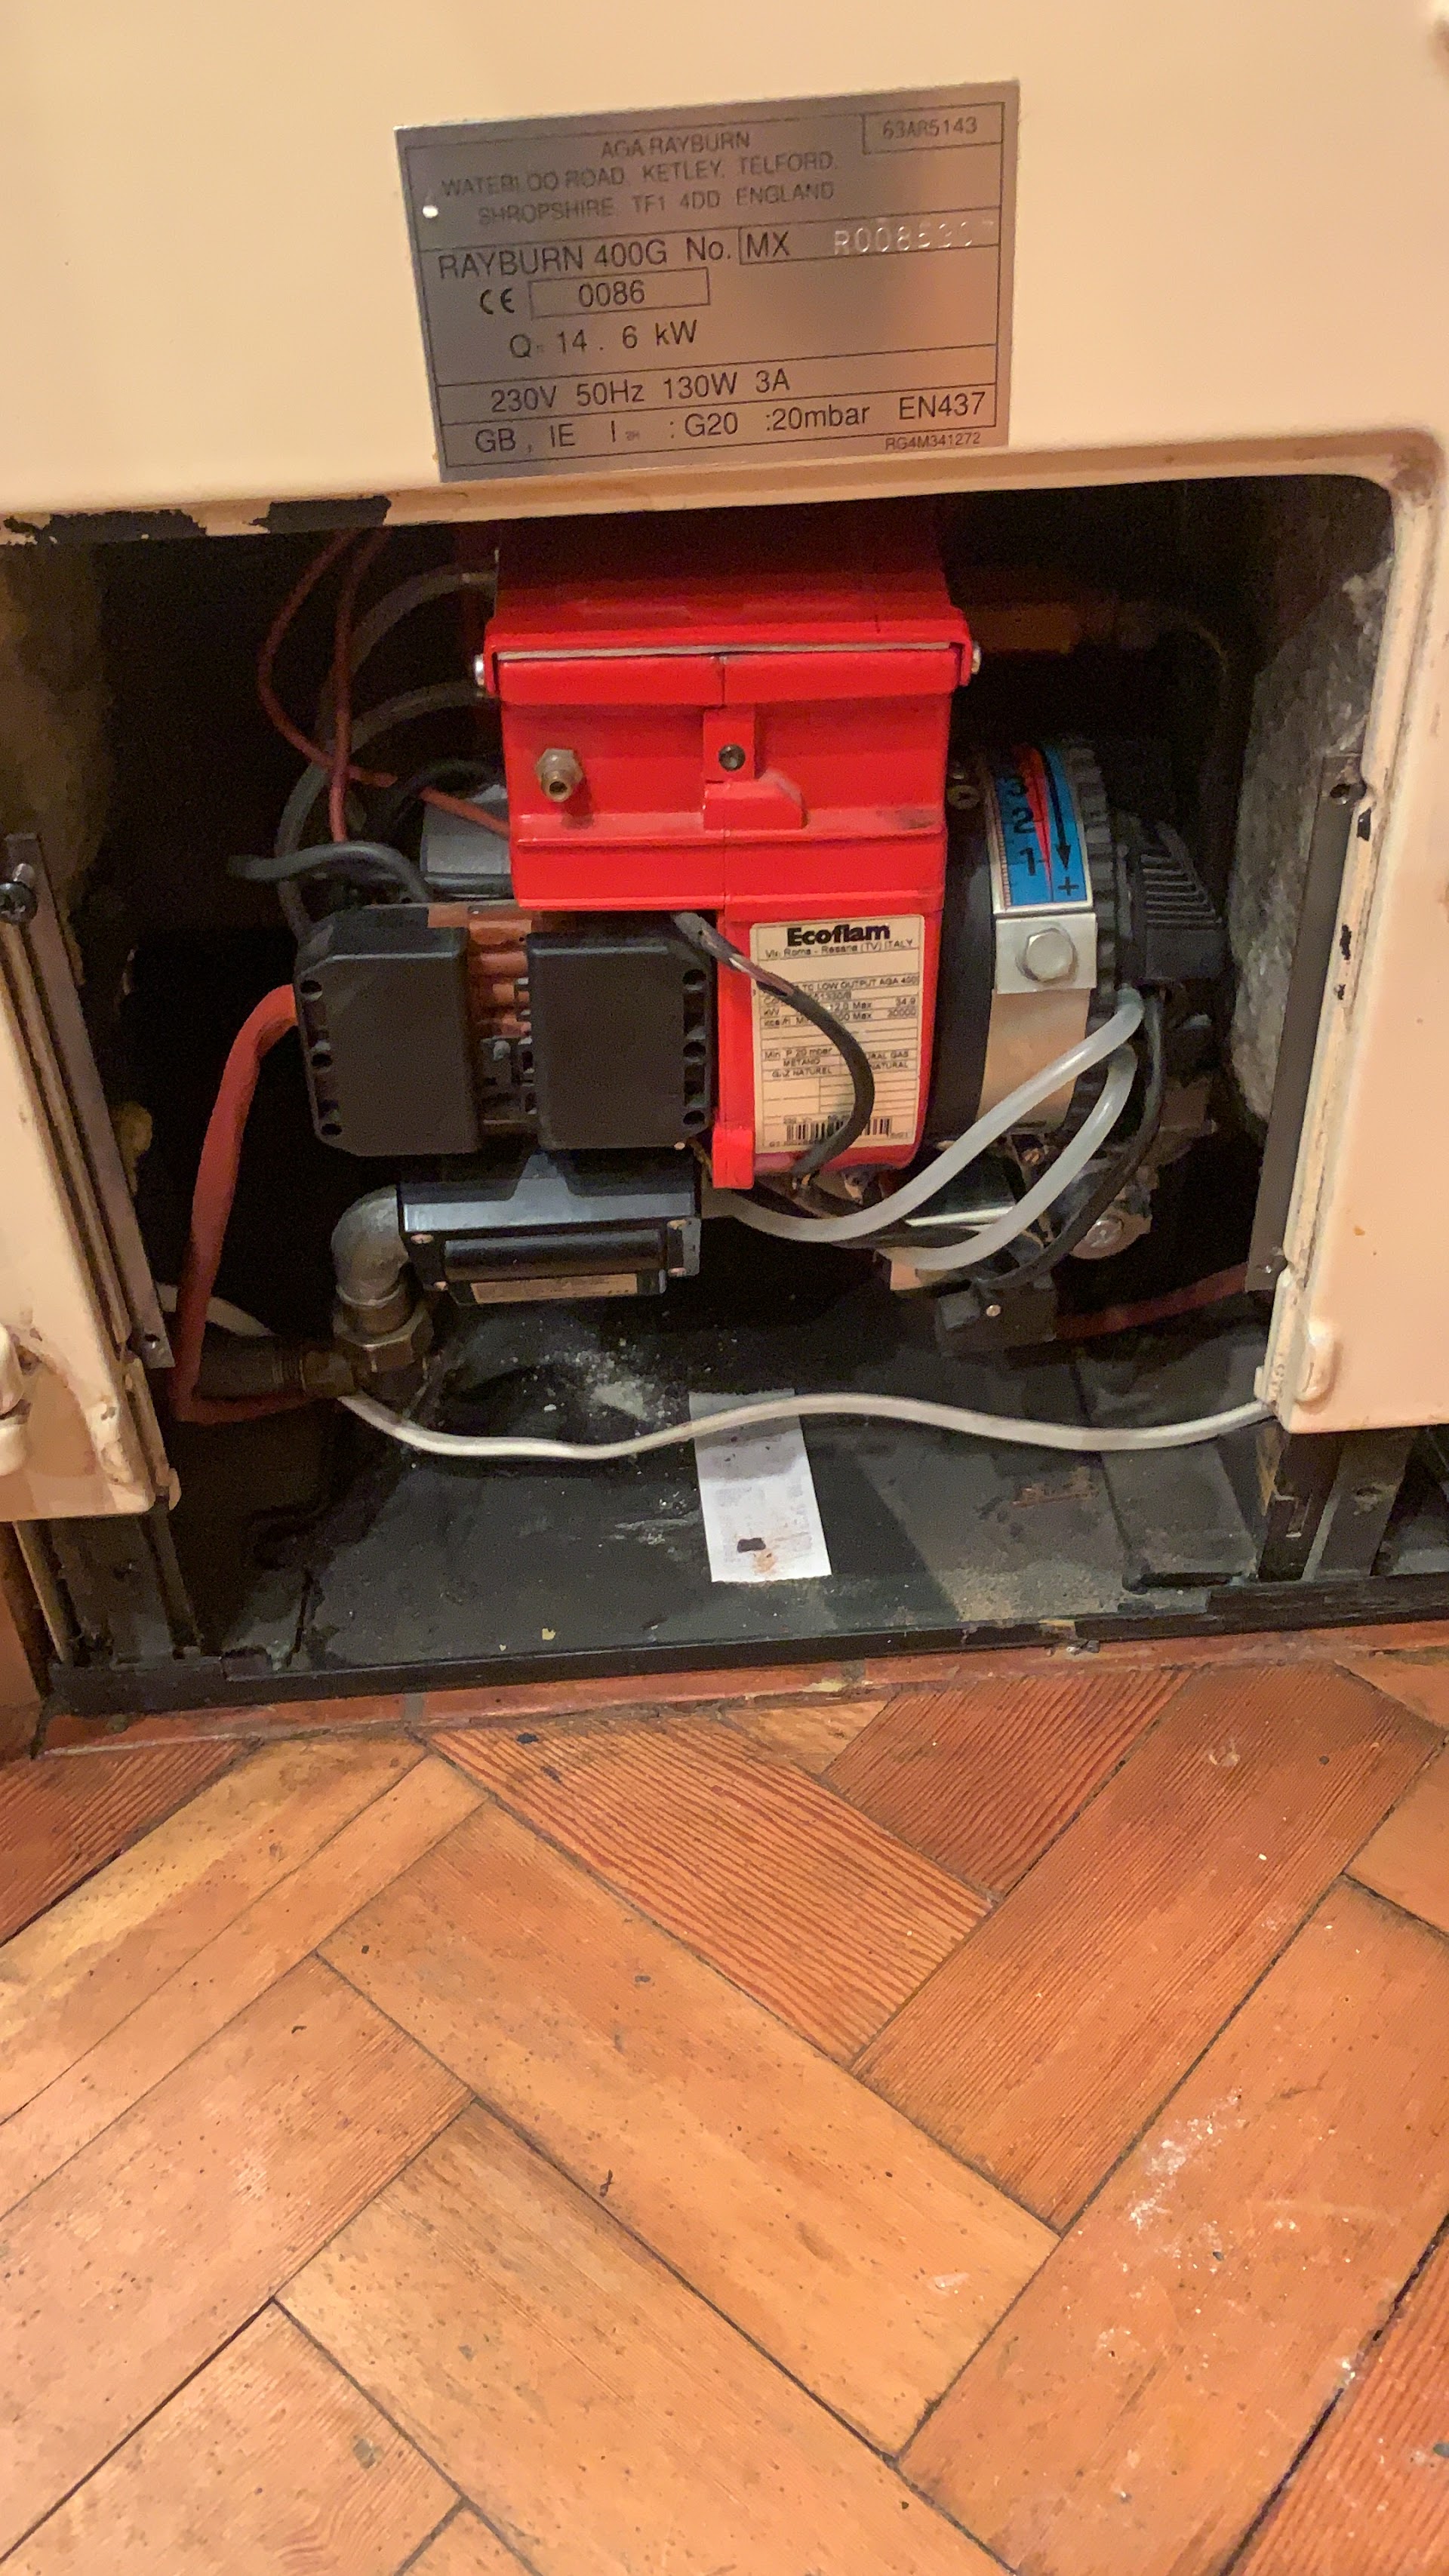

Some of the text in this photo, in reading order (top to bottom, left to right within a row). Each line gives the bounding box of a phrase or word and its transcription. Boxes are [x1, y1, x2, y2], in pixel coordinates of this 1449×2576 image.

[601, 131, 750, 158] AGA RAYBURN
[632, 195, 666, 212] TF1
[680, 190, 720, 211] 4DD
[736, 181, 835, 205] ENGLAND
[438, 245, 583, 279] RAYBURN
[594, 238, 668, 268] 400G
[686, 236, 731, 262] No.
[746, 230, 790, 258] MX
[578, 279, 645, 308] 0086
[655, 319, 697, 346] kW
[491, 368, 791, 414] 230V 50Hz 130W 3A
[549, 423, 576, 448] IE
[899, 391, 986, 420] EN437
[885, 432, 981, 451] RG4M341272
[1012, 807, 1035, 834] 2
[1020, 846, 1036, 876] 1
[786, 924, 891, 947] Ecoflam
[884, 939, 913, 949] ITALY
[817, 981, 838, 991] LOW
[840, 979, 877, 989] OUTPUT
